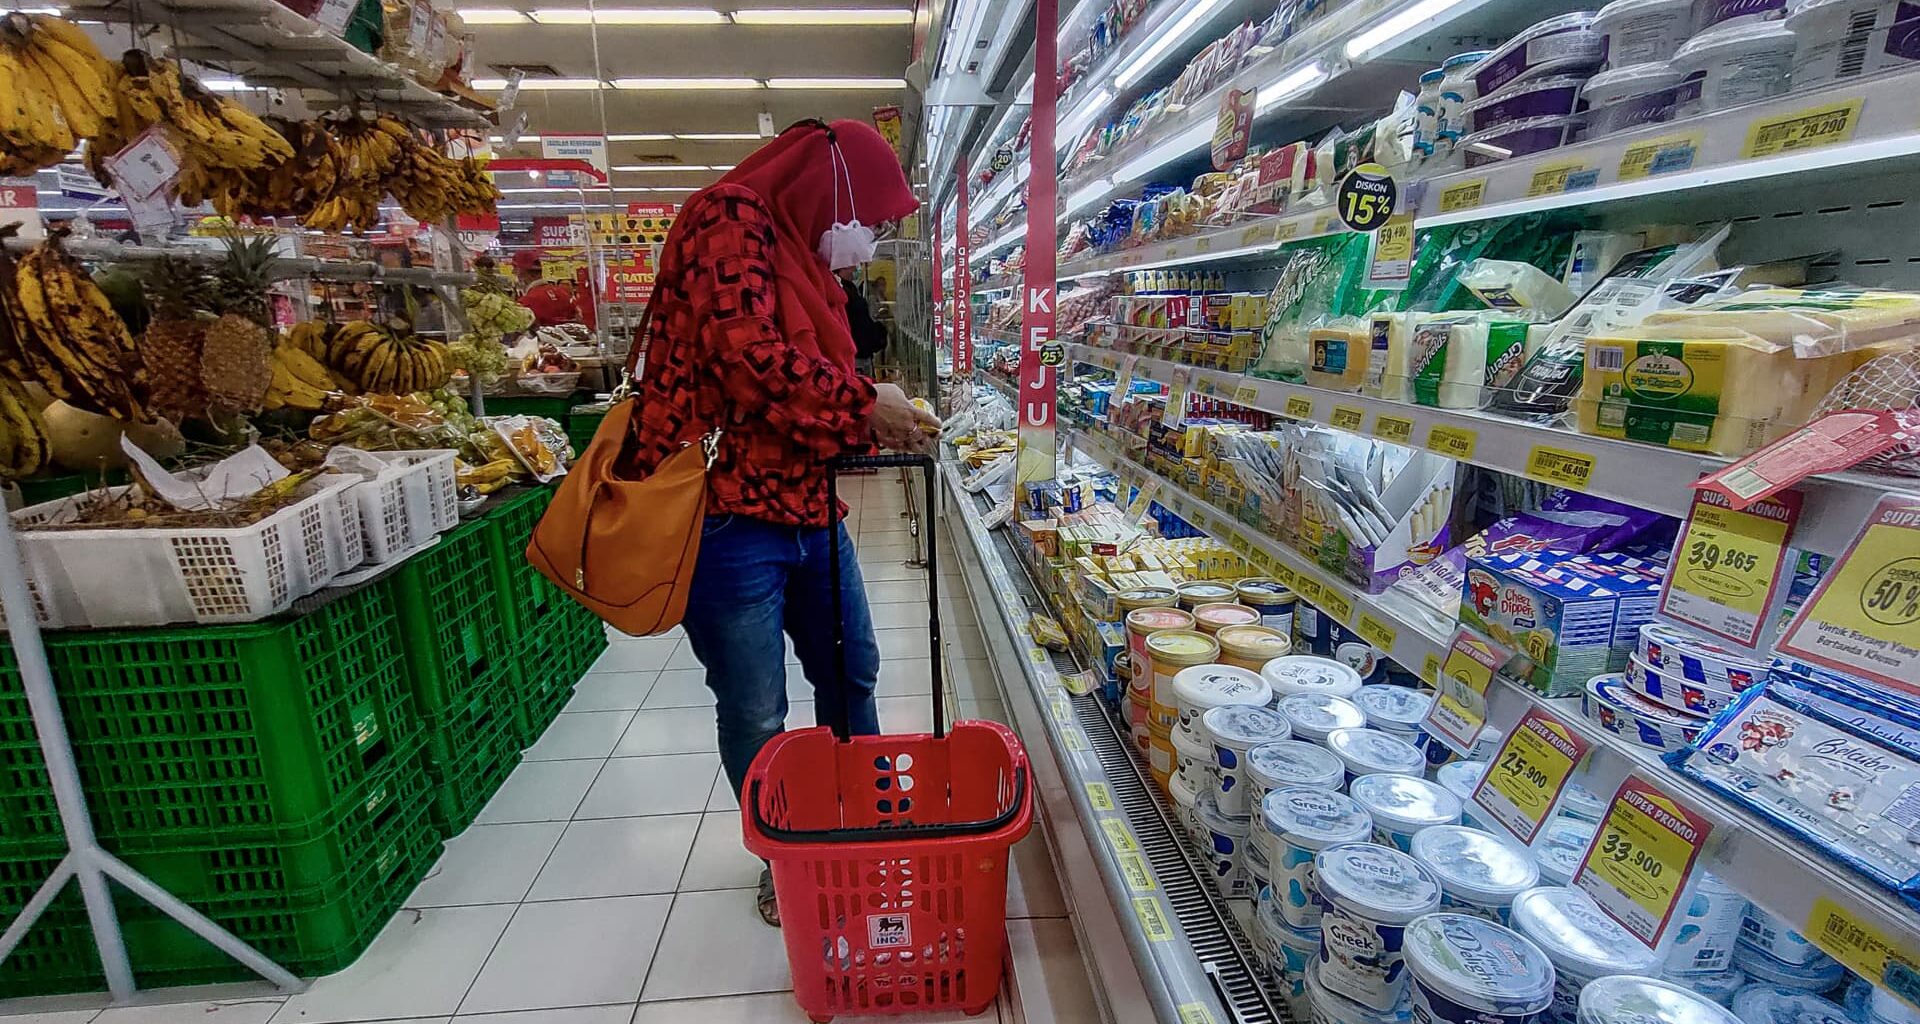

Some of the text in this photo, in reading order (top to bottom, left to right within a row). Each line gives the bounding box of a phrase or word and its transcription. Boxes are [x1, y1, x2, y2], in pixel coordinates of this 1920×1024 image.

[1800, 117, 1848, 139] 29.290
[1355, 180, 1388, 193] DISKON
[1346, 191, 1391, 225] 15%
[1027, 287, 1051, 427] KEJU
[1744, 501, 1791, 522] ROMO!
[1687, 540, 1759, 573] 39.865
[1501, 600, 1536, 619] Dippers
[1505, 588, 1531, 607] Cheez
[1816, 636, 1863, 656] Bertanda
[1817, 620, 1920, 659] Untuk Barang Yang
[1707, 699, 1718, 709] 8
[1525, 717, 1547, 737] SUPER
[1546, 733, 1579, 760] PROMO!
[1813, 737, 1891, 773] Belcube
[1500, 751, 1548, 789] 25.900
[1290, 797, 1338, 813] Greek
[1623, 789, 1656, 815] SUPER
[1654, 809, 1699, 843] PROMO!
[1346, 855, 1401, 878] Greek
[1602, 833, 1663, 879] 33.900
[876, 936, 906, 945] INDO
[1329, 923, 1375, 951] Greek
[1442, 926, 1499, 987] Delight
